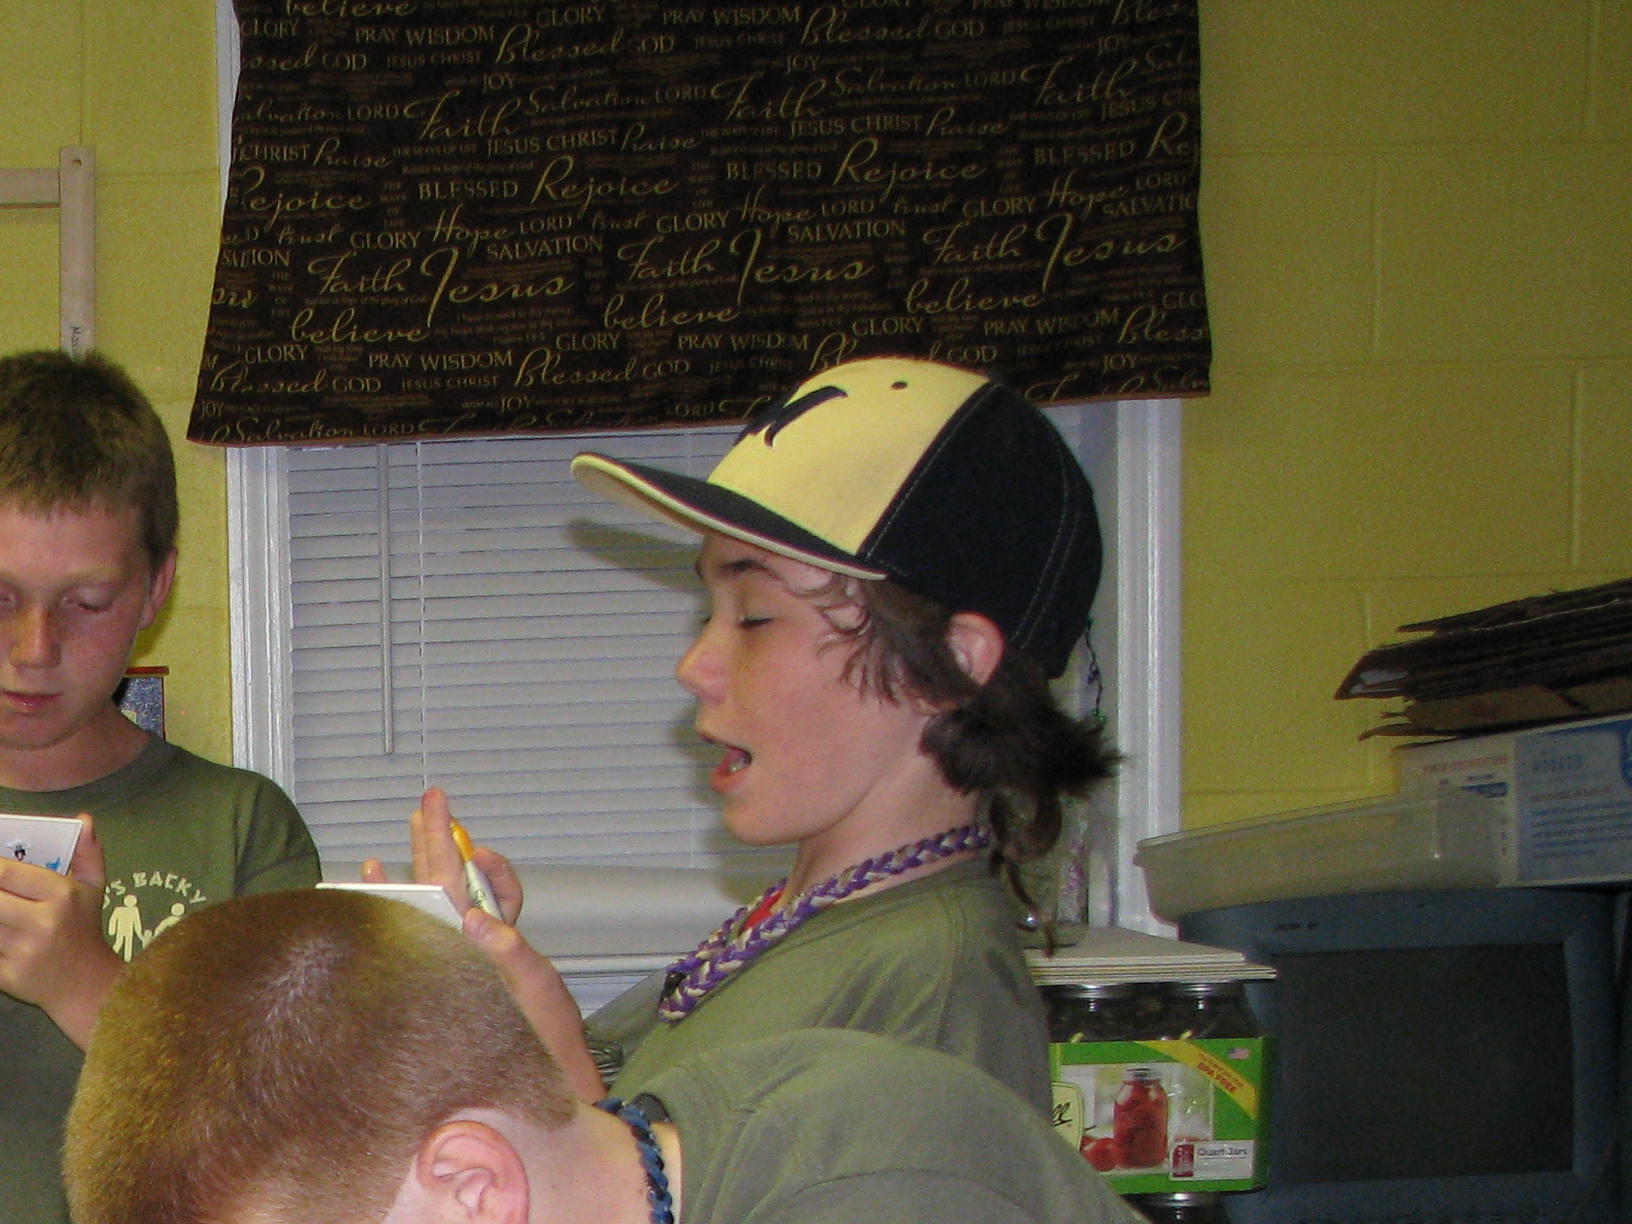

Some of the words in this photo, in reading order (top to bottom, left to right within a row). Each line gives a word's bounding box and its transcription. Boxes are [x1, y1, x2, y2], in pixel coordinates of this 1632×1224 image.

[534, 5, 609, 28] GLORY
[661, 8, 705, 25] PRAY
[712, 4, 802, 26] WISDOM
[801, 5, 931, 44] Blessed
[354, 28, 400, 44] PRAY
[406, 24, 495, 46] WISDOM
[934, 20, 986, 38] GOD
[495, 23, 624, 64] Blessed
[627, 36, 675, 54] GOD
[321, 52, 367, 71] GOD
[786, 54, 820, 76] JOY
[483, 72, 518, 94] JOY
[964, 72, 1018, 90] LORD
[1019, 56, 1140, 107] Faith
[654, 86, 708, 104] LORD
[709, 71, 829, 122] Faith
[347, 104, 400, 121] LORD
[402, 88, 523, 142] Faith
[925, 105, 1009, 137] Praise
[621, 121, 705, 153] Praise
[789, 119, 846, 140] JESUS
[849, 114, 923, 135] CHRIST
[244, 143, 310, 162] CHRIST
[312, 136, 393, 168] Praise
[487, 137, 541, 159] JESUS
[545, 129, 618, 151] CHRIST
[1033, 140, 1136, 165] BLESSED
[725, 161, 823, 182] BLESSED
[832, 137, 987, 203] Rejoice
[1134, 172, 1187, 191] LORD
[418, 180, 519, 200] BLESSED
[530, 155, 680, 221] Rejoice
[1036, 167, 1131, 222] Hope
[729, 183, 817, 239] Hope
[820, 201, 877, 217] LORD
[962, 197, 1036, 218] GLORY
[423, 203, 516, 257] Hope
[519, 215, 574, 236] LORD
[655, 209, 730, 233] GLORY
[786, 219, 907, 242] SALVATION
[350, 231, 421, 249] GLORY
[486, 235, 604, 260] SALVATION
[921, 219, 1030, 266] Faith
[615, 235, 724, 281] Faith
[1034, 212, 1189, 295] Jesus
[306, 250, 411, 296] Faith
[728, 227, 874, 307] Jesus
[419, 246, 575, 328] Jesus
[905, 276, 1044, 315] believe
[604, 293, 741, 331] believe
[291, 307, 431, 344] believe
[851, 316, 925, 337] GLORY
[982, 320, 1029, 337] PRAY
[555, 332, 622, 352] GLORY
[677, 333, 721, 351] PRAY
[244, 344, 309, 364] GLORY
[368, 353, 413, 370] PRAY
[420, 350, 513, 371] WISDOM
[947, 344, 998, 364] GOD
[1101, 352, 1137, 375] JOY
[514, 347, 636, 387] Blessed
[642, 360, 691, 380] GOD
[331, 376, 383, 394] GOD
[199, 402, 225, 419] JOY
[500, 395, 534, 416] JOY
[362, 421, 416, 437] LORD
